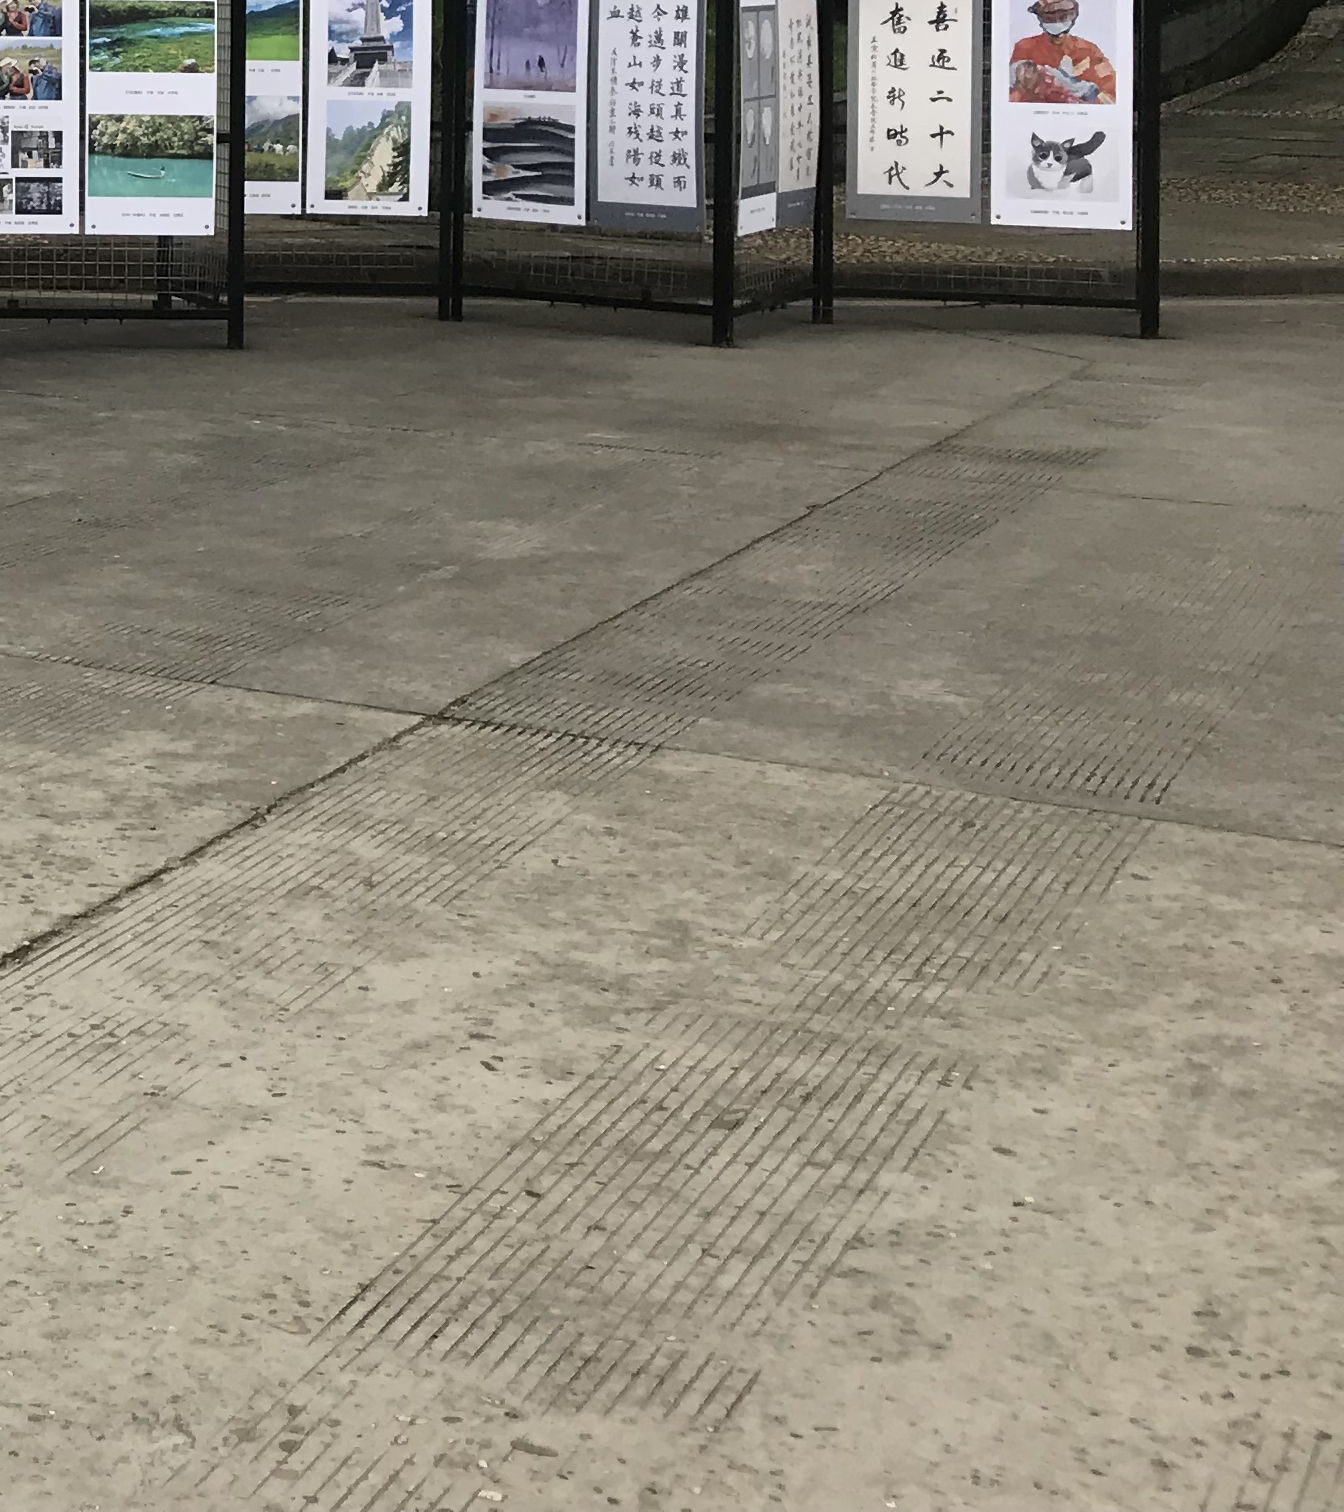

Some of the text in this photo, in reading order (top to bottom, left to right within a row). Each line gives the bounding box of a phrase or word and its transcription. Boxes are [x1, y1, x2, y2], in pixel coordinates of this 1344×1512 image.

[606, 5, 625, 20] 血
[923, 1, 958, 188] 喜迎二十大
